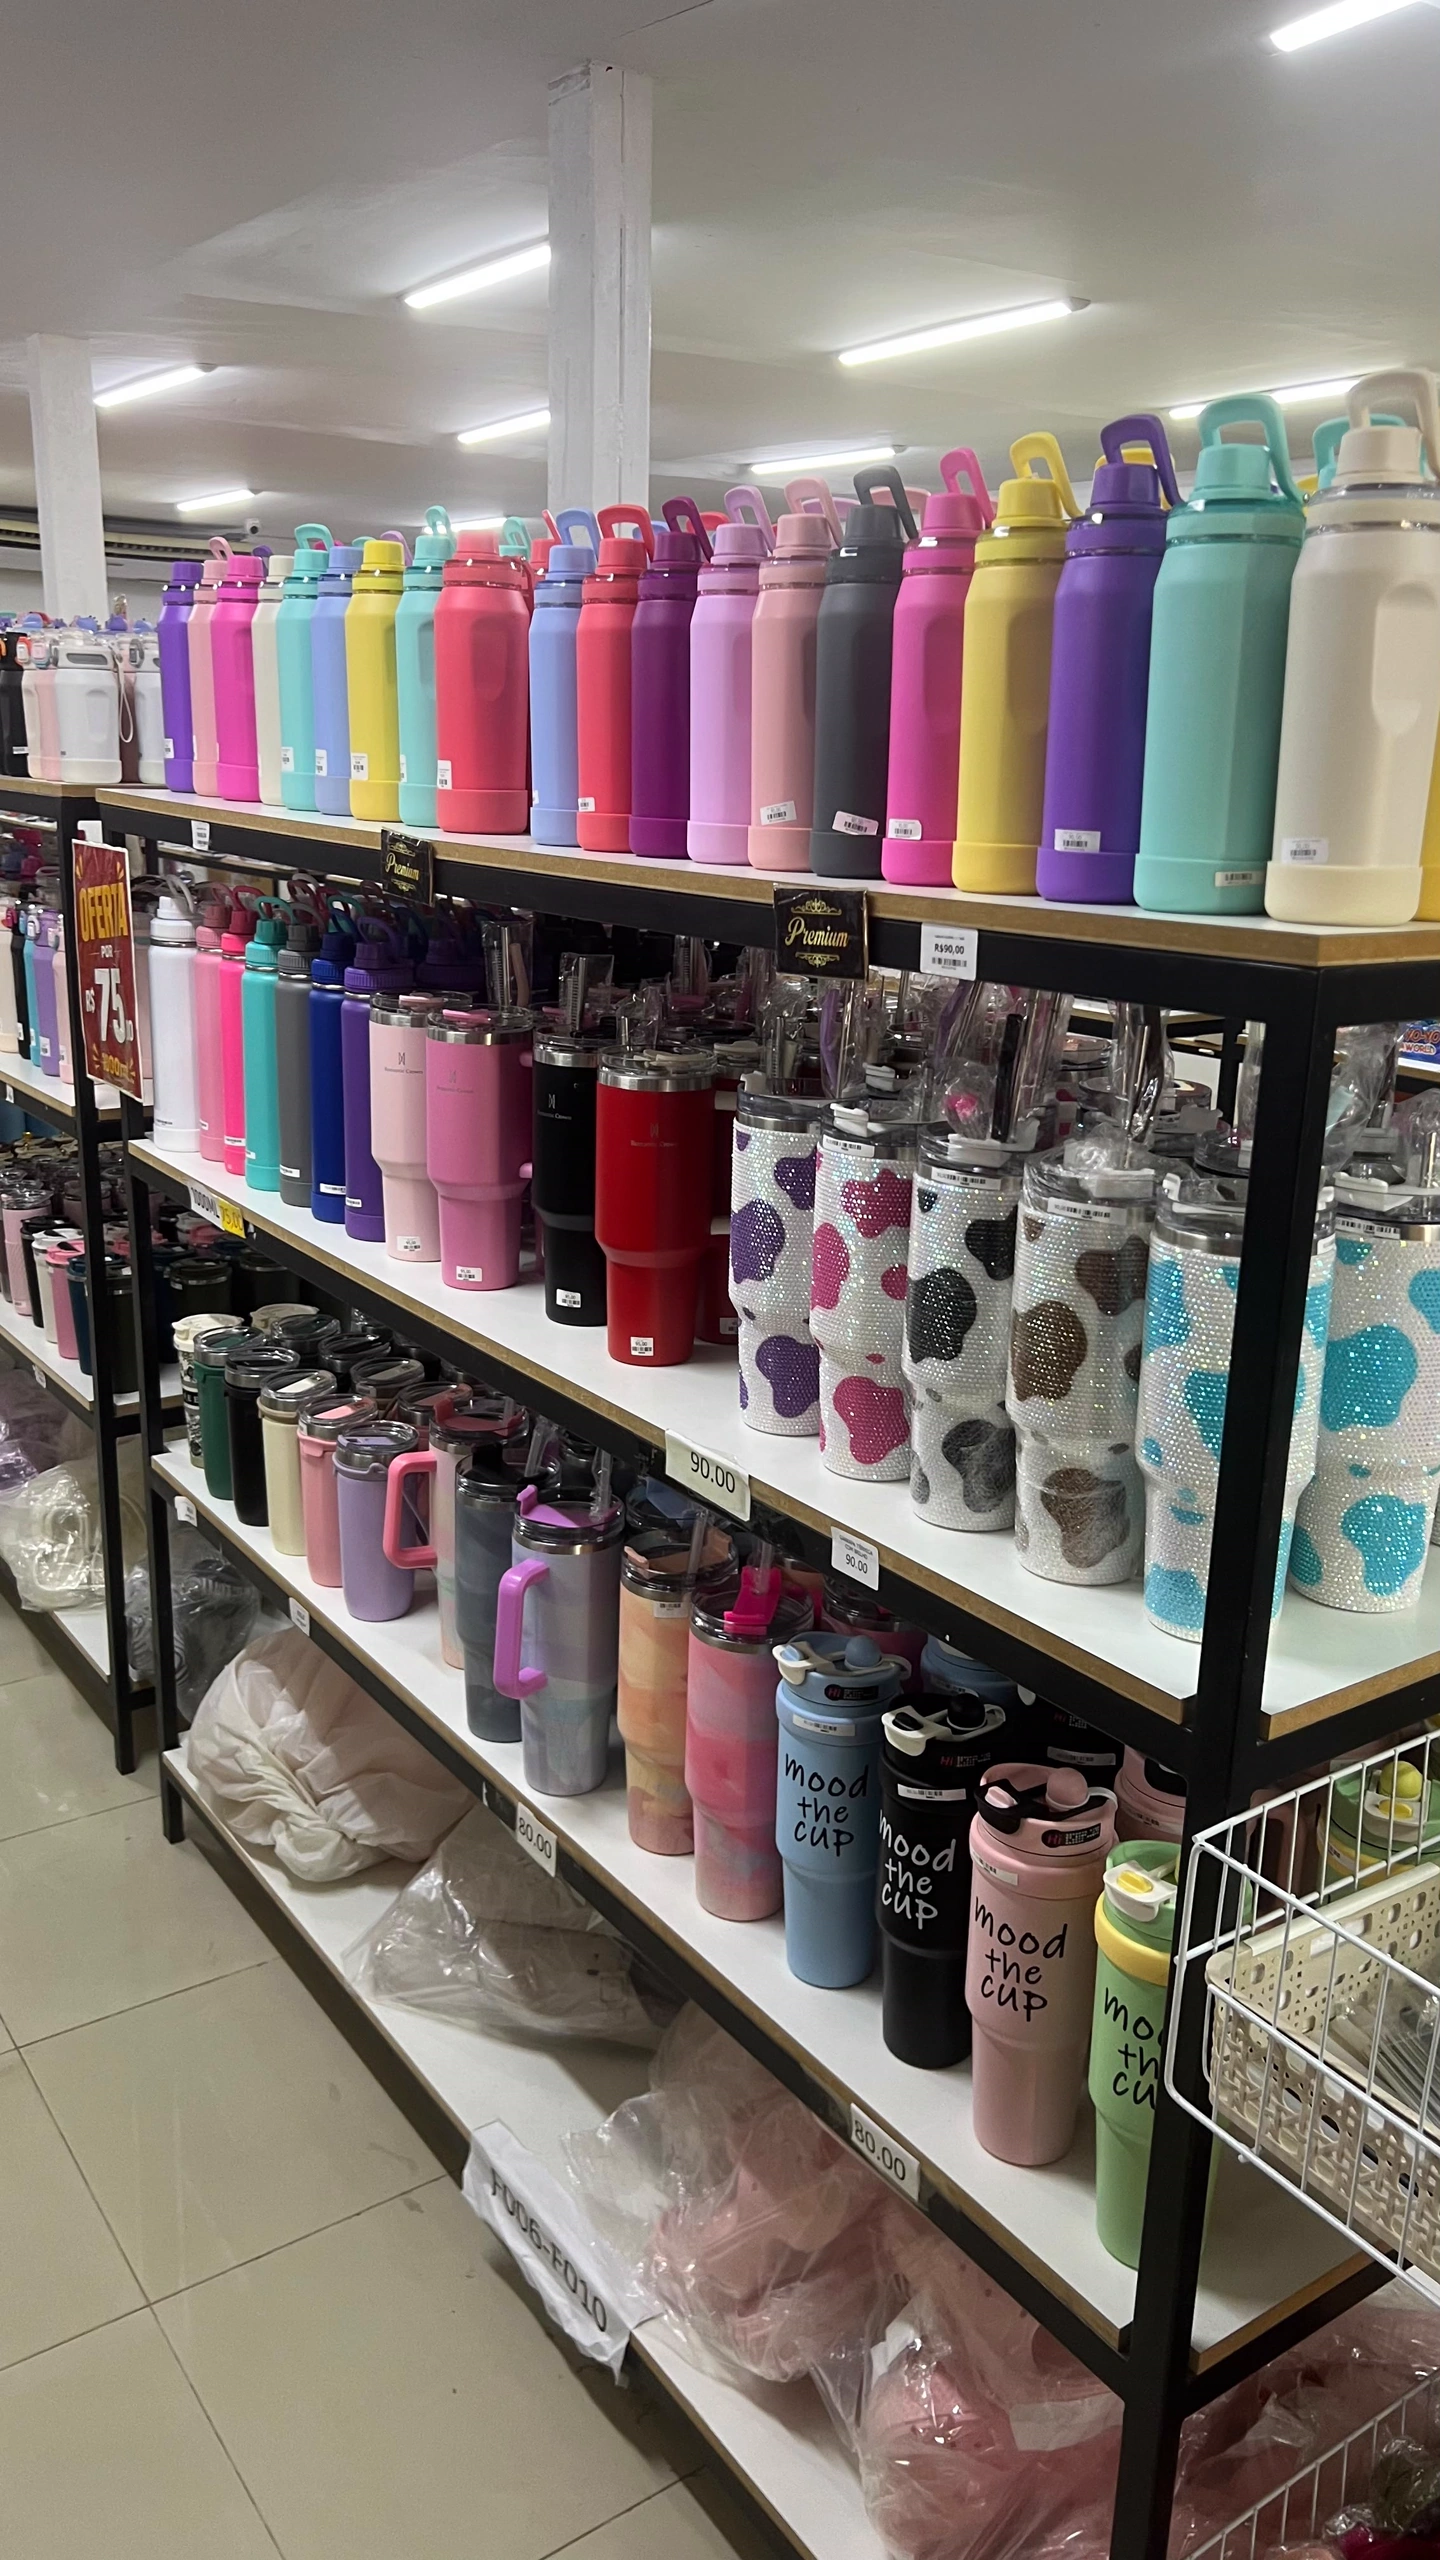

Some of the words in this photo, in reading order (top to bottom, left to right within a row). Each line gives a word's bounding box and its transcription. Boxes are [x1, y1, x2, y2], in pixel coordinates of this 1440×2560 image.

[385, 853, 419, 881] Premium
[79, 882, 128, 942] OFERTA
[784, 916, 848, 947] Premium
[934, 943, 965, 956] R$90,00
[101, 945, 113, 958] POR
[85, 987, 95, 1013] R$
[190, 1187, 220, 1219] 1000ML
[690, 1451, 736, 1493] 90.00
[845, 1553, 868, 1574] 90.00
[785, 1753, 869, 1798] mood
[797, 1796, 849, 1825] the
[518, 1817, 552, 1859] 80.00
[794, 1821, 854, 1857] cup
[879, 1809, 956, 1872] mood
[884, 1858, 932, 1894] the
[881, 1883, 938, 1930] cup
[974, 1896, 1068, 1958] mood
[985, 1948, 1042, 1985] the
[981, 1975, 1048, 2022] cup
[1118, 2043, 1159, 2079] th
[1113, 2071, 1157, 2110] cu
[855, 2120, 906, 2181] 80.00
[491, 2167, 607, 2332] F006-F010
